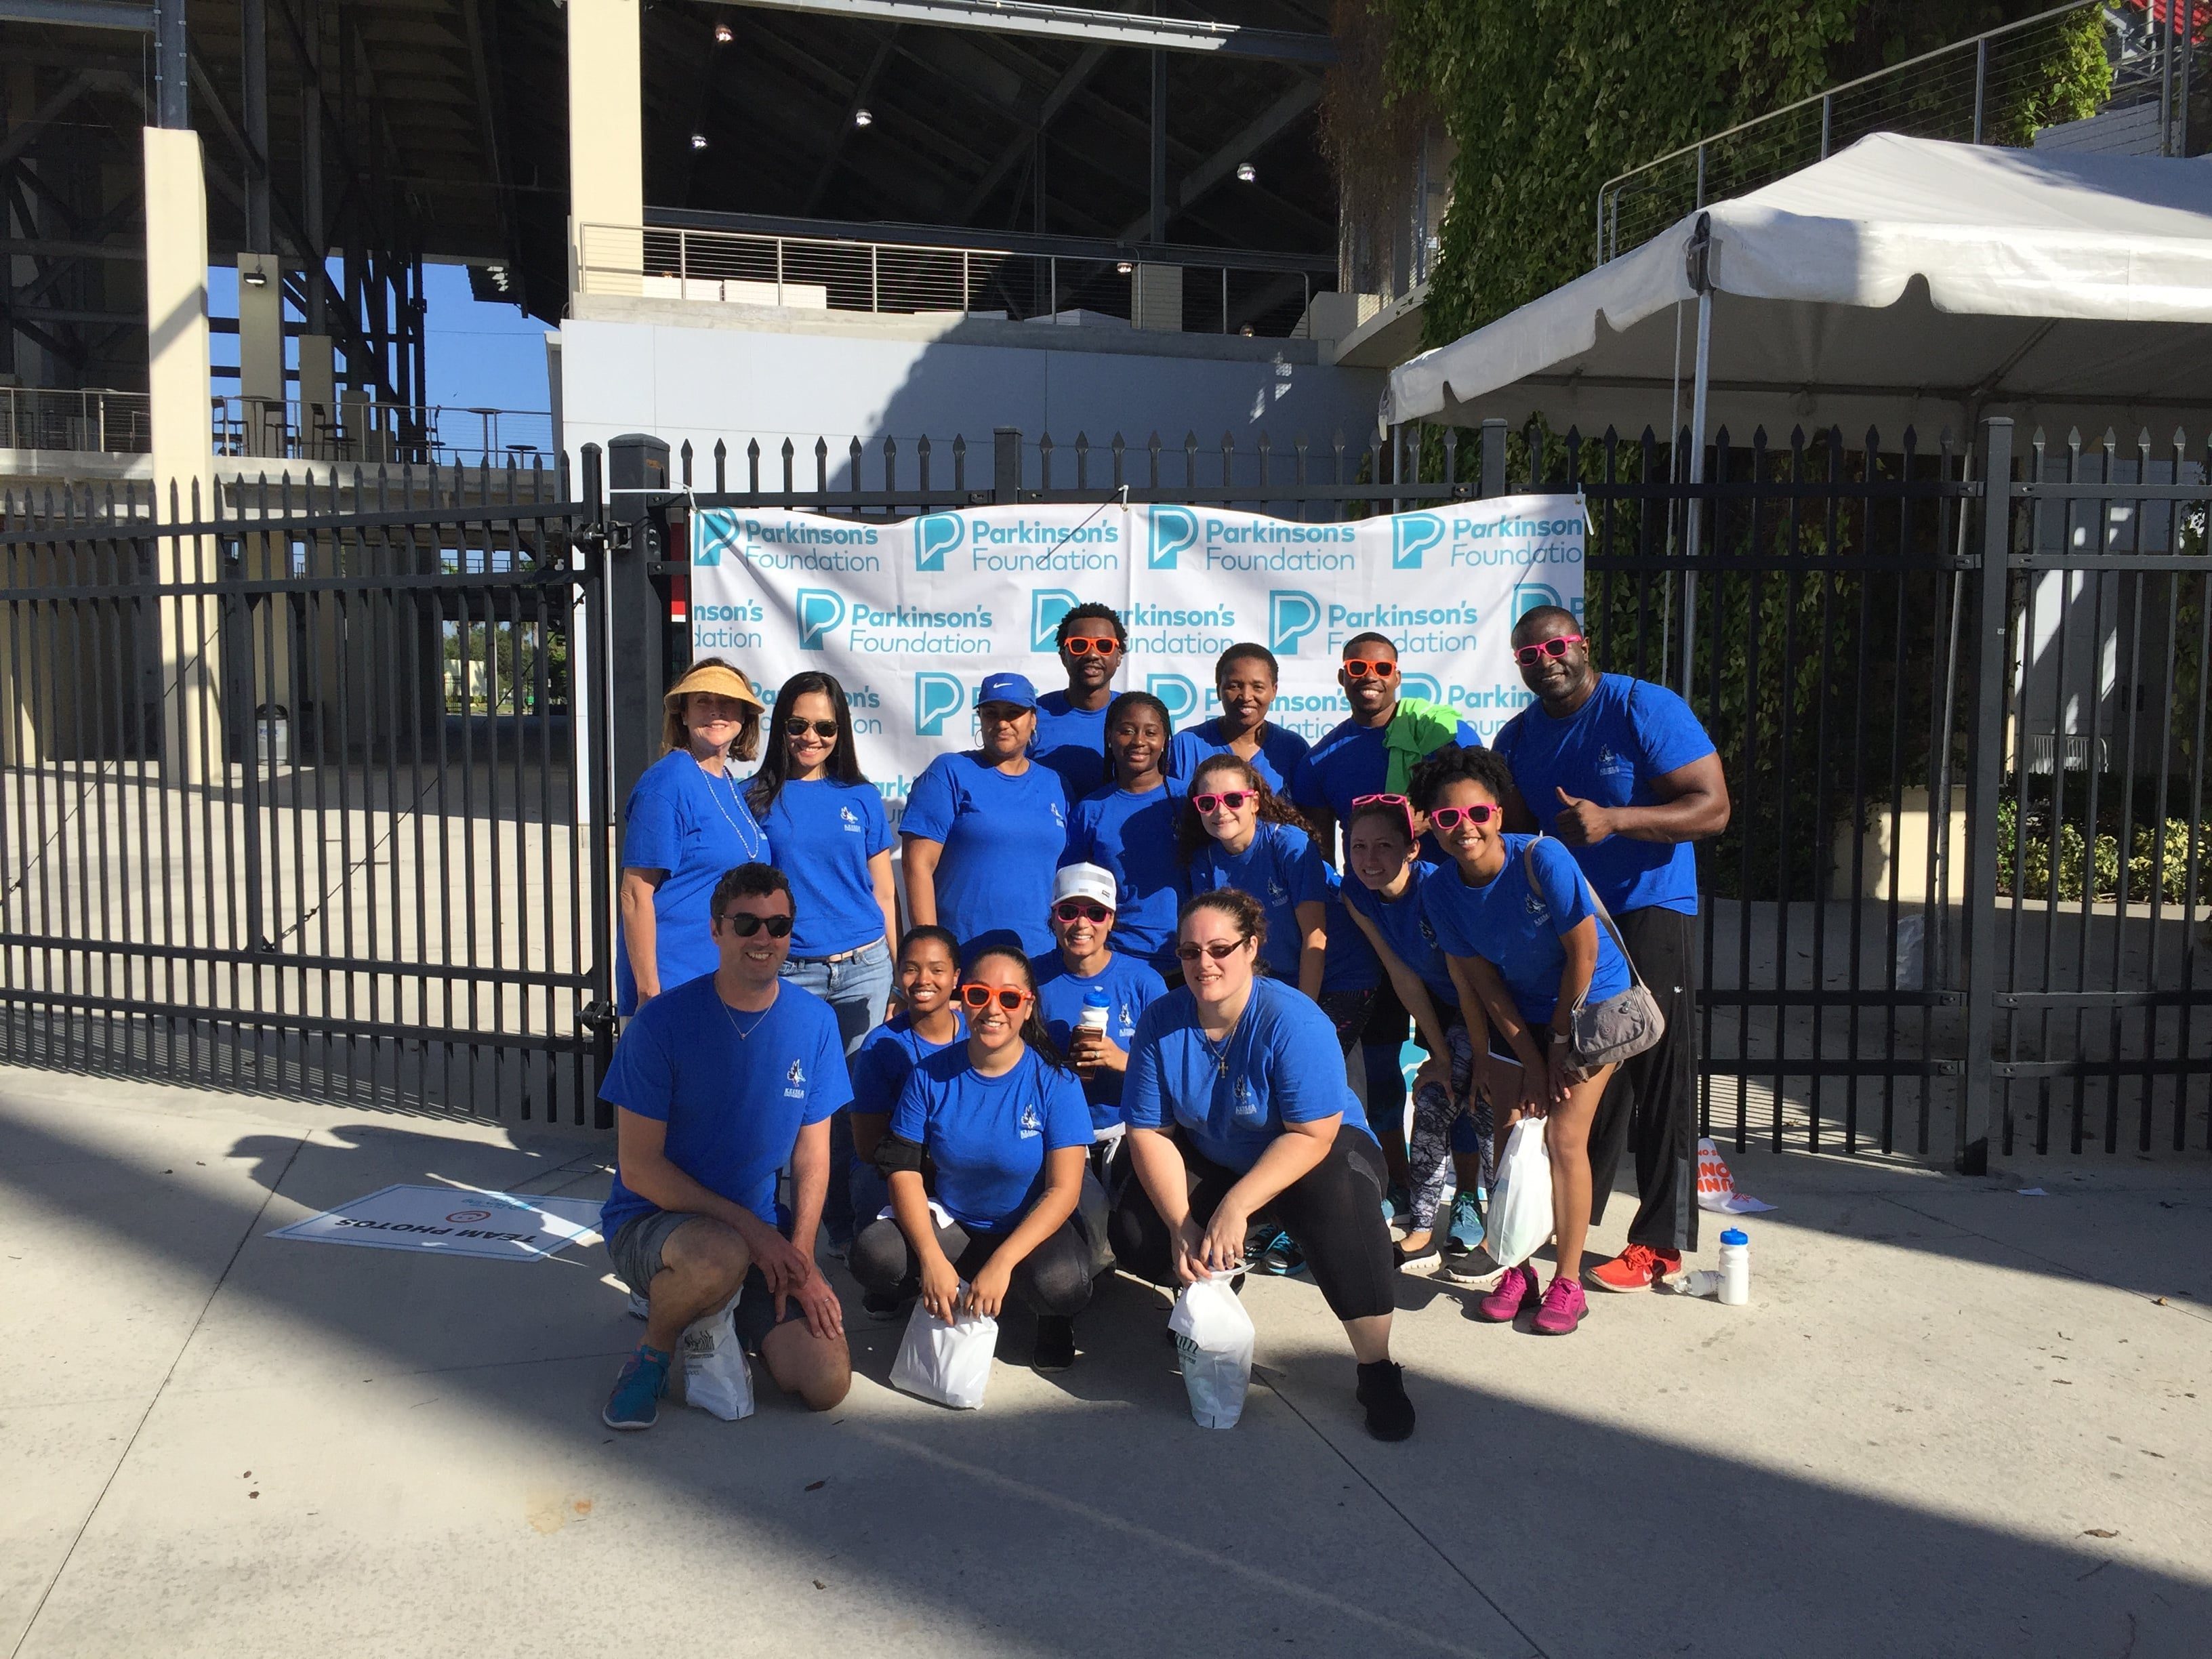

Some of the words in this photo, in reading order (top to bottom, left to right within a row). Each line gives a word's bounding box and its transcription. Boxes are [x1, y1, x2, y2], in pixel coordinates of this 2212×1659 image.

[745, 520, 878, 545] Parkinson's
[972, 520, 1118, 544] Parkinson's
[1206, 519, 1355, 543] Parkinson's
[1454, 515, 1582, 539] Parkinson
[745, 546, 879, 571] Foundation
[972, 548, 1118, 571] Foundation
[1206, 547, 1355, 571] Foundation
[1451, 541, 1582, 567] Foundatio
[852, 604, 992, 628] Parkinson's
[1328, 600, 1478, 628] Parkinson's
[849, 630, 990, 653] Foundation
[335, 1219, 454, 1236] PHOTOS
[455, 1229, 537, 1243] TEAM
